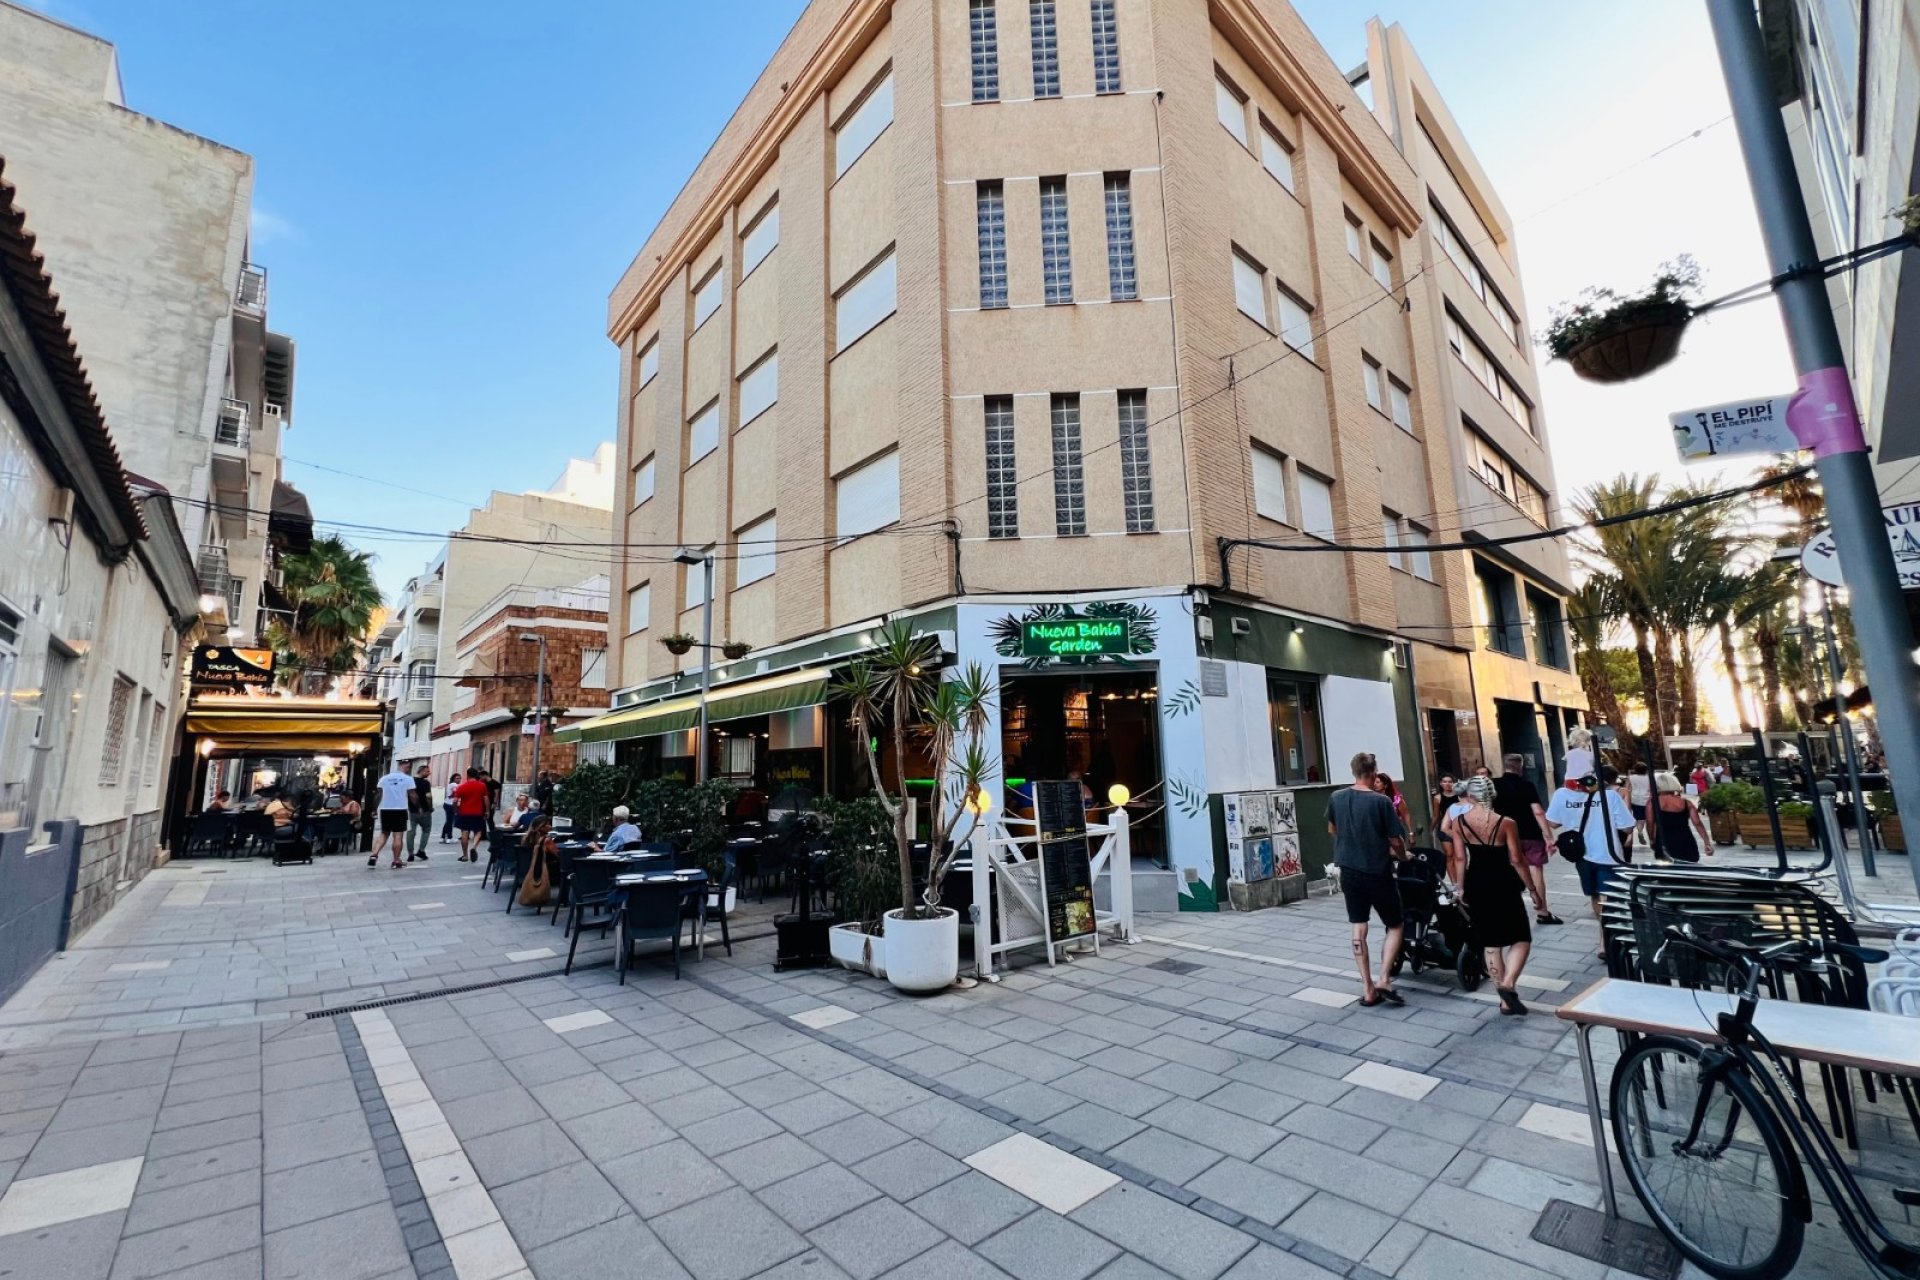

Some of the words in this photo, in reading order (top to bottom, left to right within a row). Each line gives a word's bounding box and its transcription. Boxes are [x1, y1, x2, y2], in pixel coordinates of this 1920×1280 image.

[1711, 411, 1734, 424] EL
[1737, 400, 1773, 419] PIPÍ
[1728, 415, 1774, 427] DESTRUYE
[1030, 624, 1076, 639] Nueva
[1077, 622, 1122, 638] Bahía
[1049, 639, 1103, 654] Garden
